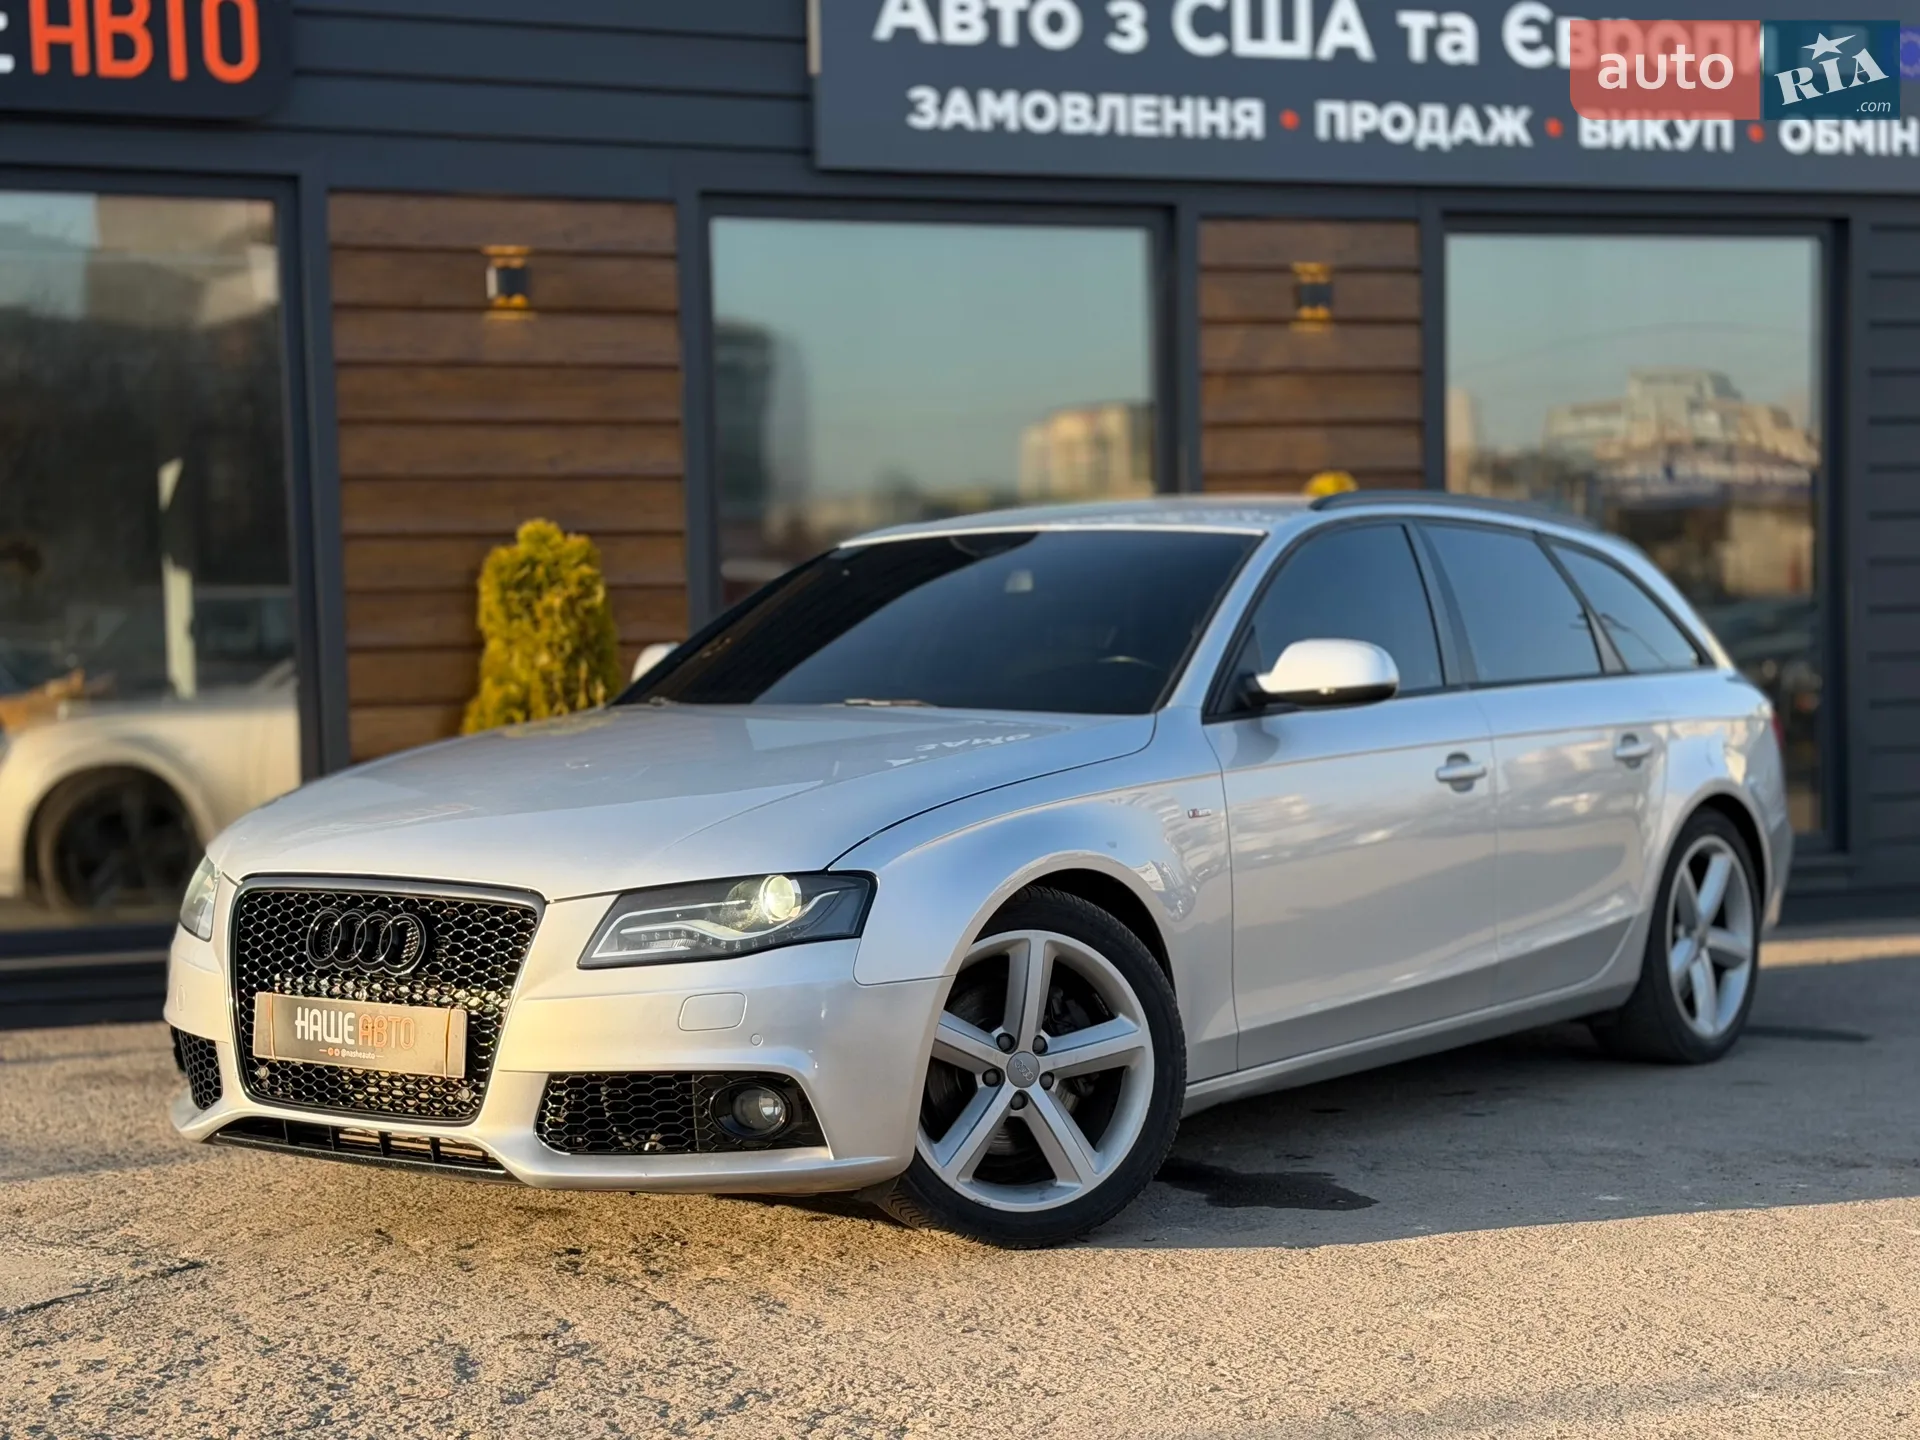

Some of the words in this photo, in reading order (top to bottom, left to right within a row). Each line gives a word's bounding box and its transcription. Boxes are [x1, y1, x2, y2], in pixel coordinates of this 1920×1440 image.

[1172, 0, 1377, 62] США
[1396, 10, 1480, 66] та
[906, 85, 1265, 140] ЗАМОВЛЕННЯ
[1315, 99, 1535, 151] ПРОДАЖ
[1577, 106, 1735, 153] ВИКУП
[1778, 113, 1920, 157] ОБМІН
[295, 1006, 356, 1045] НАШЕ
[358, 1013, 416, 1050] АВТО
